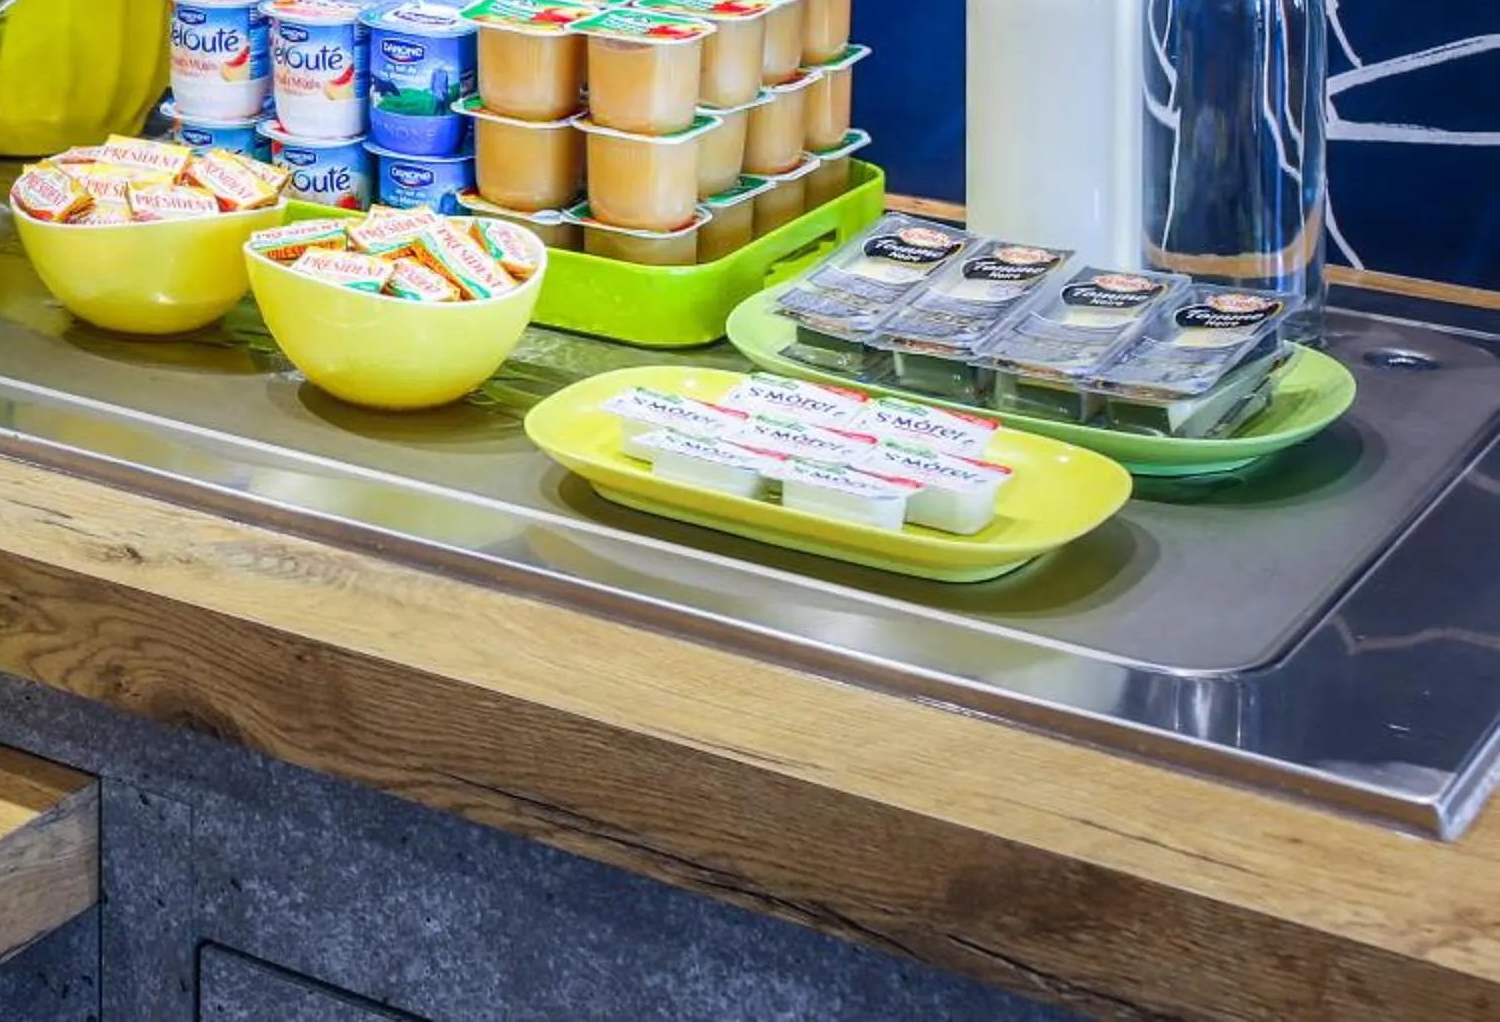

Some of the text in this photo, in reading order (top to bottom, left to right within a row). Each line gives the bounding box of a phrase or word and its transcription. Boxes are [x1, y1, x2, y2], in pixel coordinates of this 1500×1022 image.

[172, 23, 239, 53] elouté
[275, 44, 343, 71] elouté
[291, 166, 349, 192] outé
